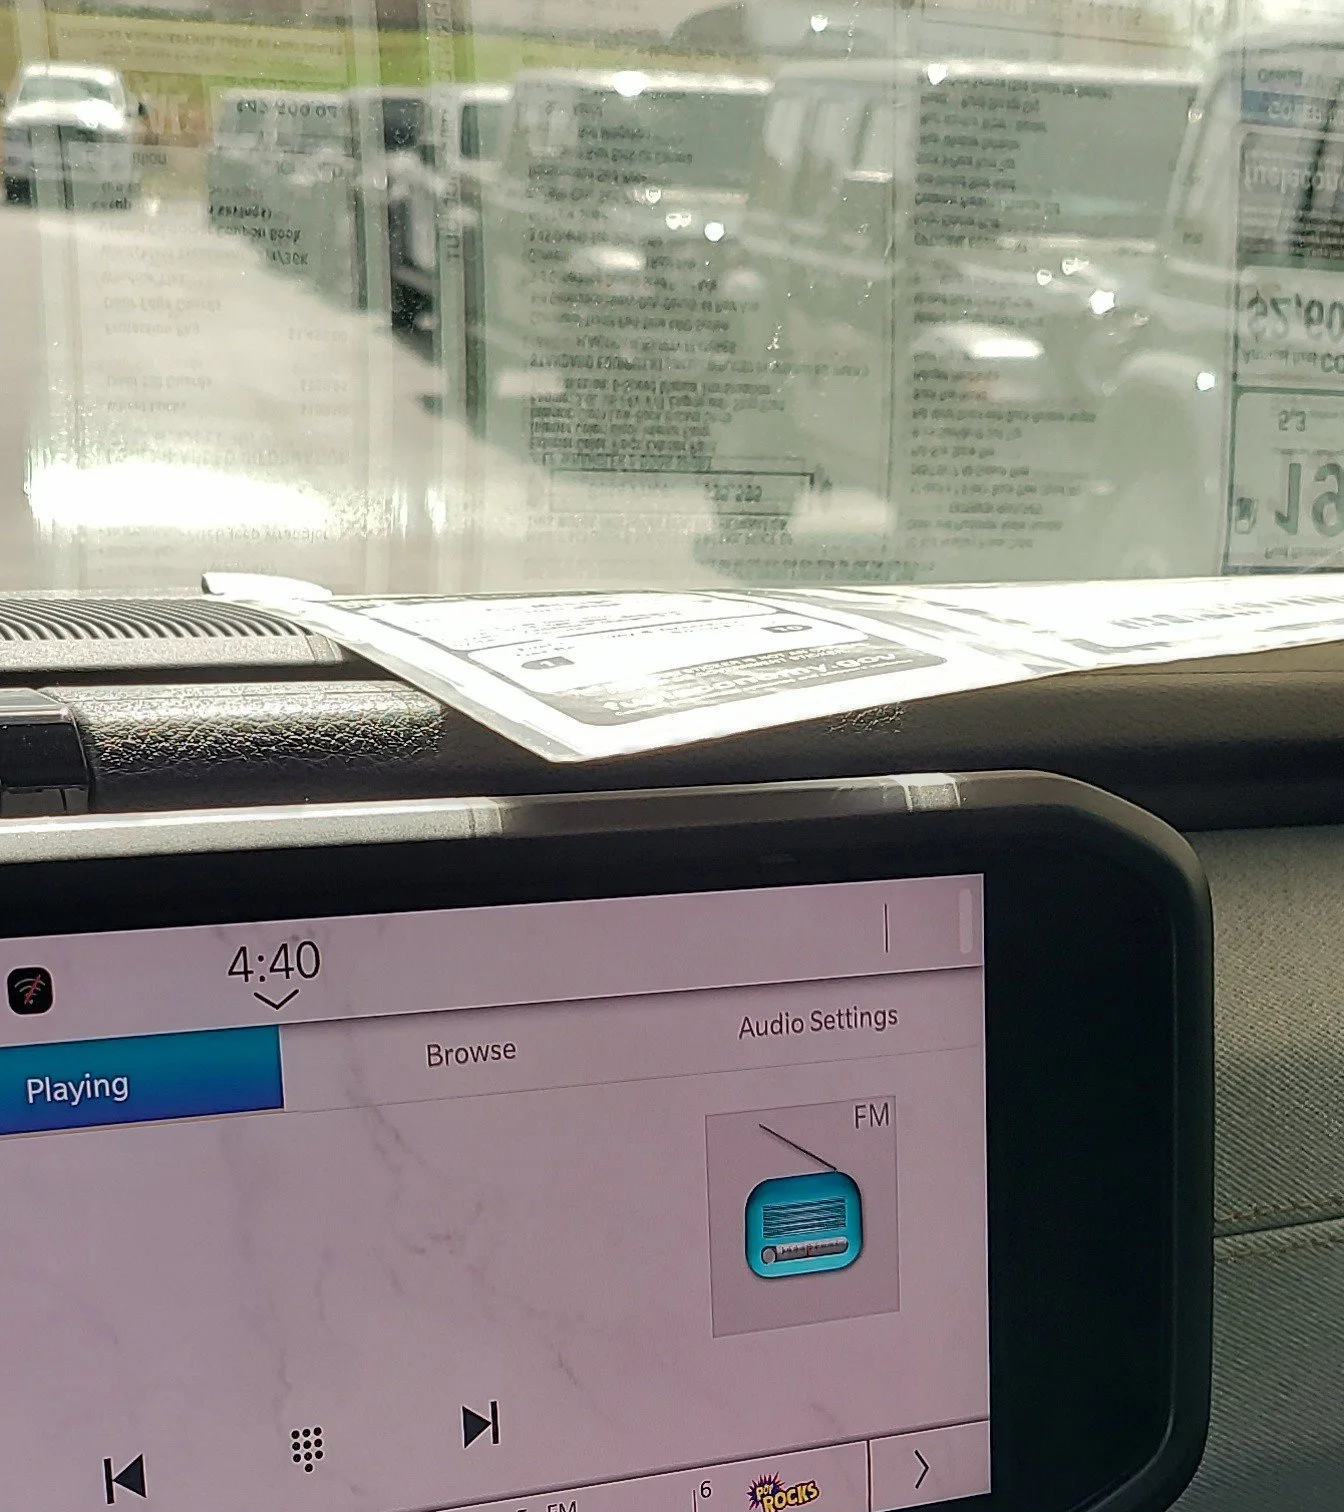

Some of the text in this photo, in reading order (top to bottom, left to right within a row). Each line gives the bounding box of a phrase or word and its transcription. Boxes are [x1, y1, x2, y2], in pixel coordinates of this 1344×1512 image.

[227, 940, 321, 983] 4:40
[738, 1004, 899, 1041] Audio Settings
[426, 1038, 517, 1069] Browse
[25, 1073, 130, 1106] Playing
[854, 1103, 891, 1130] FM
[699, 1480, 712, 1500] 6
